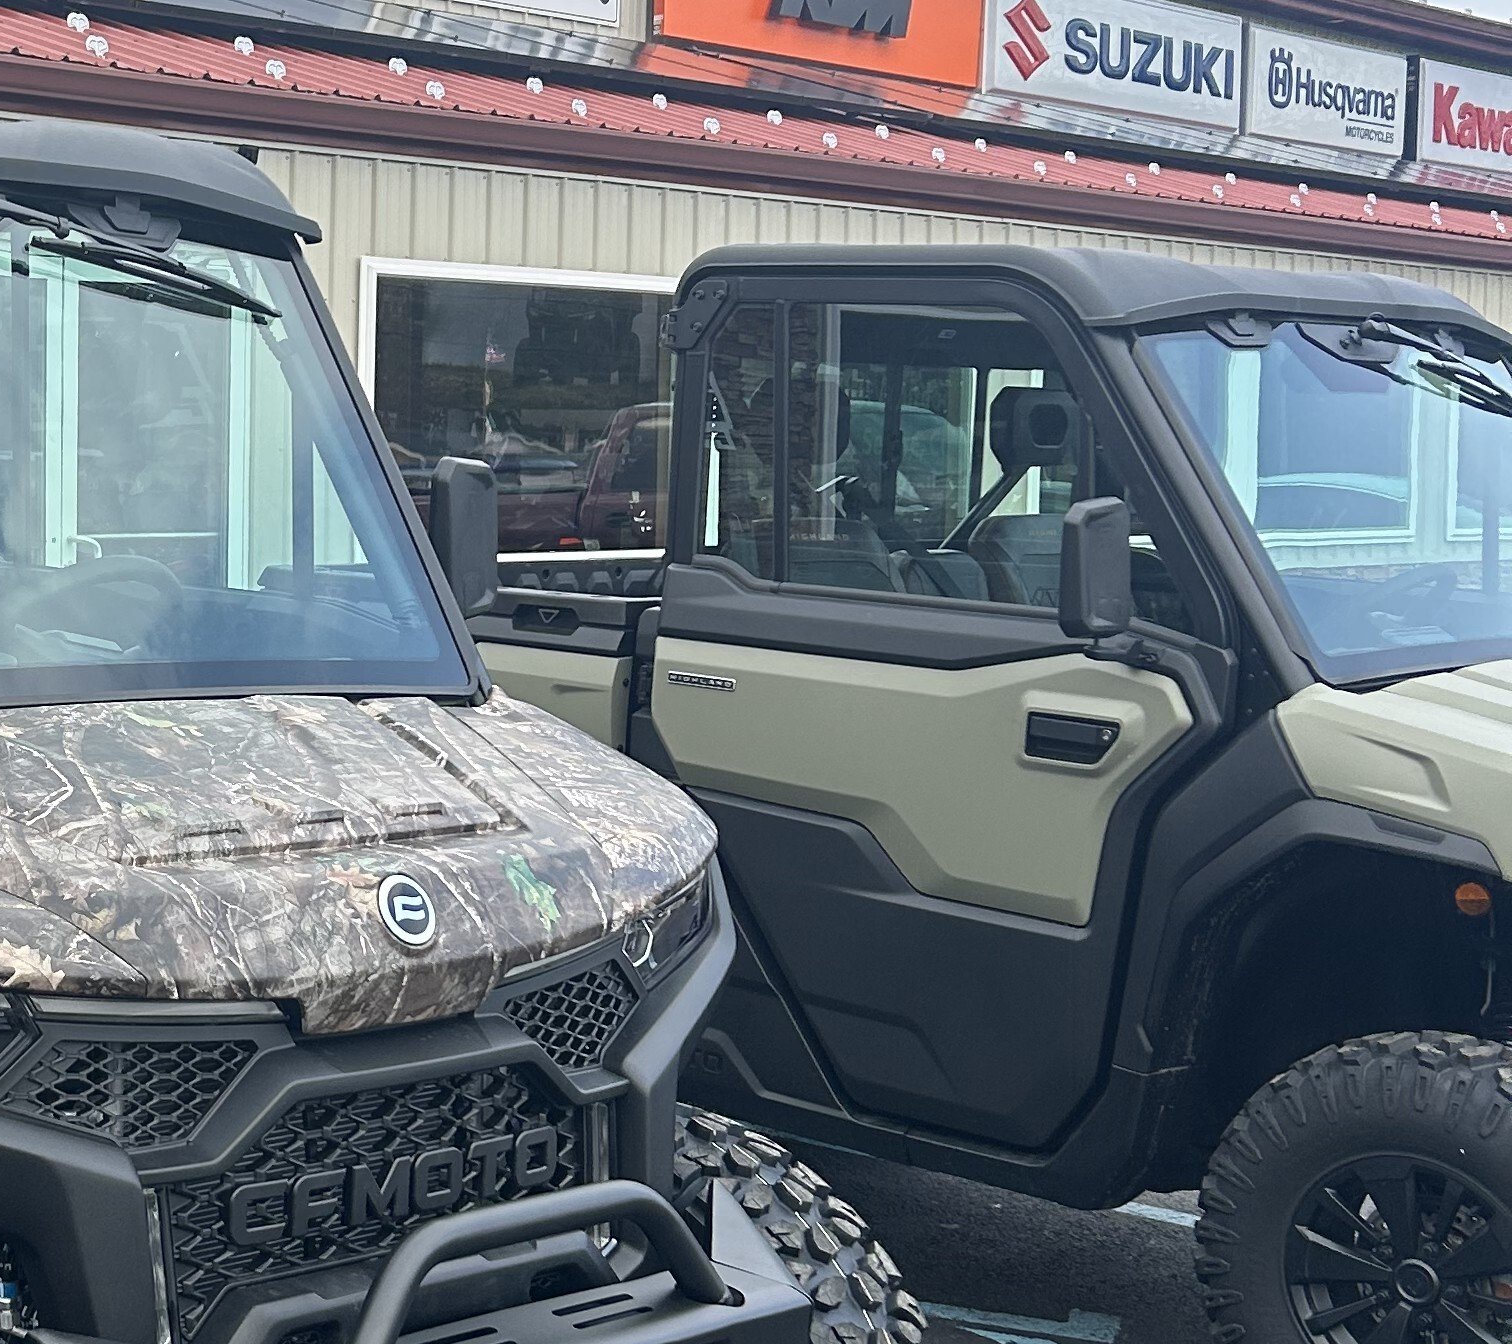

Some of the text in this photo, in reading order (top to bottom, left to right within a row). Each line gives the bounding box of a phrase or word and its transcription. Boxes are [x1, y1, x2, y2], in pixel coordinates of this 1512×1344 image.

[1063, 17, 1235, 101] SUZUKI
[1294, 66, 1396, 121] Husqvarna
[1345, 124, 1395, 145] MOTORCYCLES
[229, 1125, 558, 1246] CFMOTO
